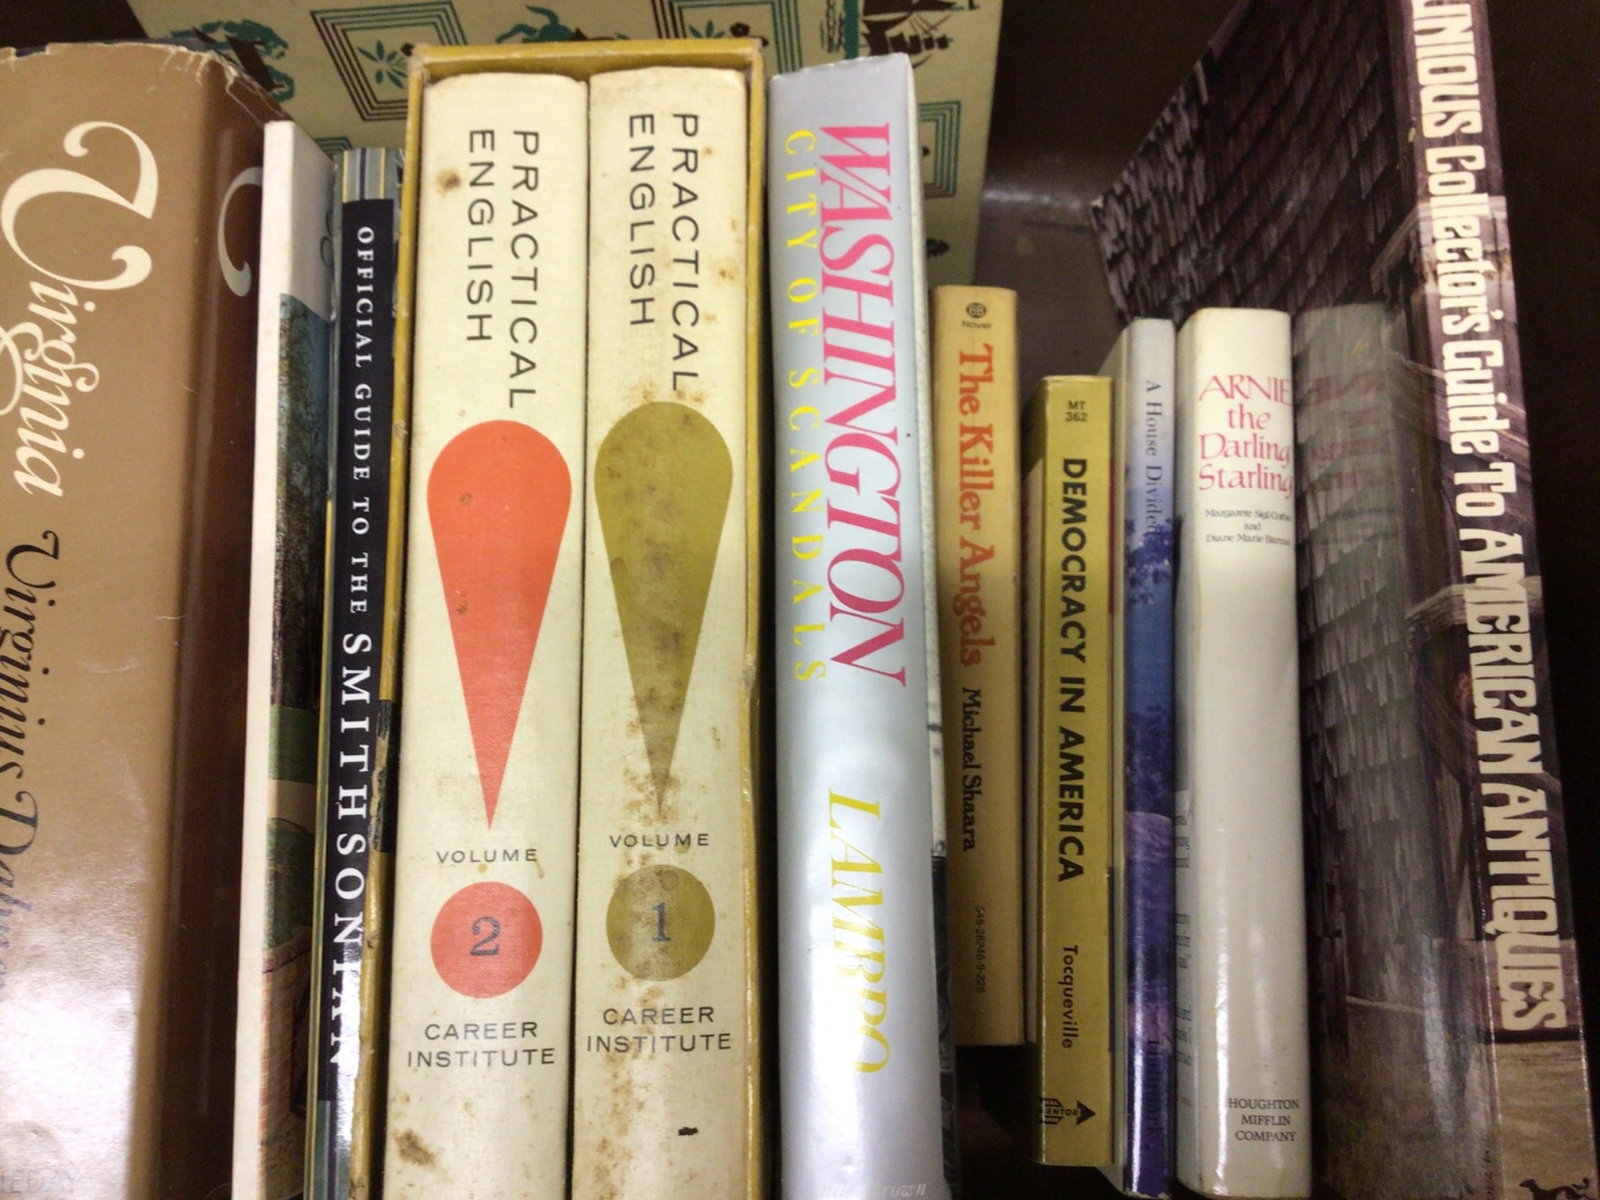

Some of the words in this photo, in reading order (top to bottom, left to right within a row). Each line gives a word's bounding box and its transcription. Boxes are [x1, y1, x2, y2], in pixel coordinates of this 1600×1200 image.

[628, 113, 656, 325] ENGLISH
[785, 129, 819, 250] CITY
[466, 129, 495, 342] ENGLISH
[671, 113, 700, 391] PRACTICAL
[1424, 145, 1504, 336] Collector's
[355, 226, 375, 367] OFFICIAL
[509, 129, 540, 409] PRACTICAL
[0, 121, 159, 497] Virginia
[787, 276, 820, 336] OF
[819, 121, 907, 688] WASHINGTON
[957, 342, 995, 416] The
[1067, 401, 1086, 411] MT
[1145, 380, 1162, 392] A
[1198, 374, 1292, 406] ARNIE
[1441, 339, 1510, 455] Guide
[353, 384, 371, 482] GUIDE
[1065, 411, 1088, 422] 362
[1145, 402, 1163, 456] House
[1227, 402, 1271, 430] the
[957, 423, 995, 530] Killer
[1198, 462, 1294, 500] Starling
[1199, 432, 1292, 469] Darling
[350, 498, 370, 536] TO
[788, 366, 827, 681] SCANDALS
[1145, 465, 1163, 536] Divided
[1243, 522, 1262, 531] and
[349, 552, 369, 615] THE
[1060, 458, 1088, 664] DEMOCRACY
[952, 544, 997, 668] Angels
[1459, 529, 1546, 775] AMERICAN
[1058, 677, 1085, 713] IN
[961, 687, 983, 770] Michael
[961, 773, 983, 853] Shaara
[1057, 726, 1085, 883] AMERICA
[436, 848, 538, 864] VOLUME
[609, 833, 710, 849] VOLUME
[469, 915, 501, 958] 2
[650, 901, 672, 943] 1
[1481, 782, 1568, 1031] ANTIQUES
[602, 1006, 716, 1025] CAREER
[1058, 944, 1079, 1050] Tocqueville
[408, 1047, 556, 1068] INSTITUTE
[424, 1021, 539, 1041] CAREER
[586, 1032, 732, 1053] INSTITUTE
[1043, 1107, 1079, 1117] ENTOR
[1228, 1098, 1300, 1110] HOUGHTON
[1240, 1114, 1291, 1126] MIFFLIN
[1235, 1130, 1296, 1142] COMPANY
